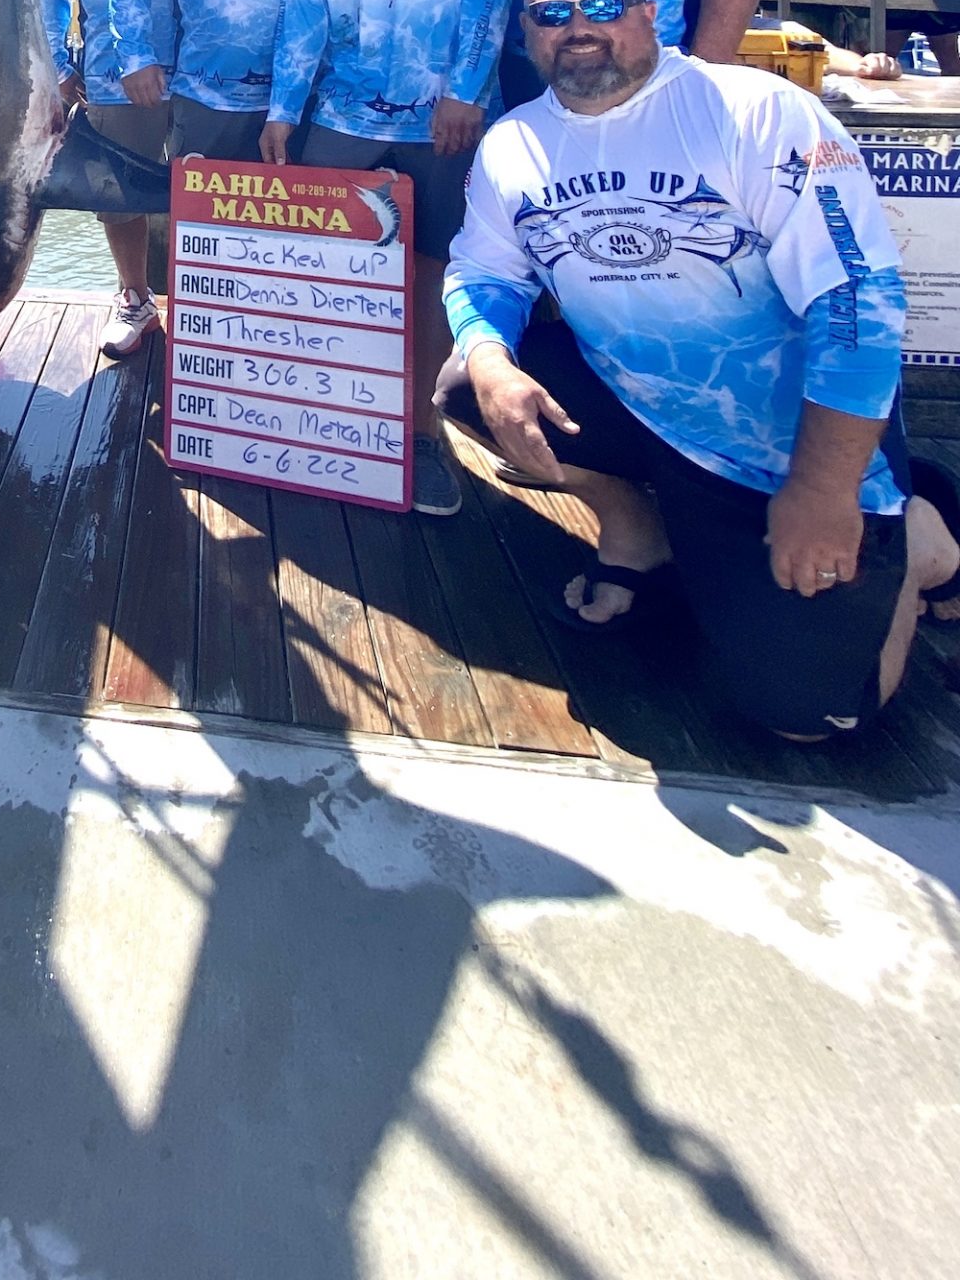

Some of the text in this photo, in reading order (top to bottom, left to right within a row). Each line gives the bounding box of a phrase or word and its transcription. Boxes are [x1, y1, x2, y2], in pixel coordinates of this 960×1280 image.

[184, 170, 348, 201] BAHIA 410-289-7438
[541, 170, 686, 207] JACKED UP
[212, 198, 352, 233] MARINA
[580, 206, 646, 218] SPORTFISHING
[181, 235, 219, 257] BOAT
[609, 233, 636, 245] Old
[609, 243, 645, 256] No.7
[181, 273, 234, 299] ANGLER
[589, 274, 637, 283] MOREHEAD
[180, 312, 211, 336] FISH
[217, 315, 345, 352] Thresher
[178, 351, 234, 380] WEIGHT
[243, 358, 332, 395] 306.3
[178, 393, 217, 418] CAPT.
[226, 398, 282, 432] Dean
[177, 433, 213, 459] DATE
